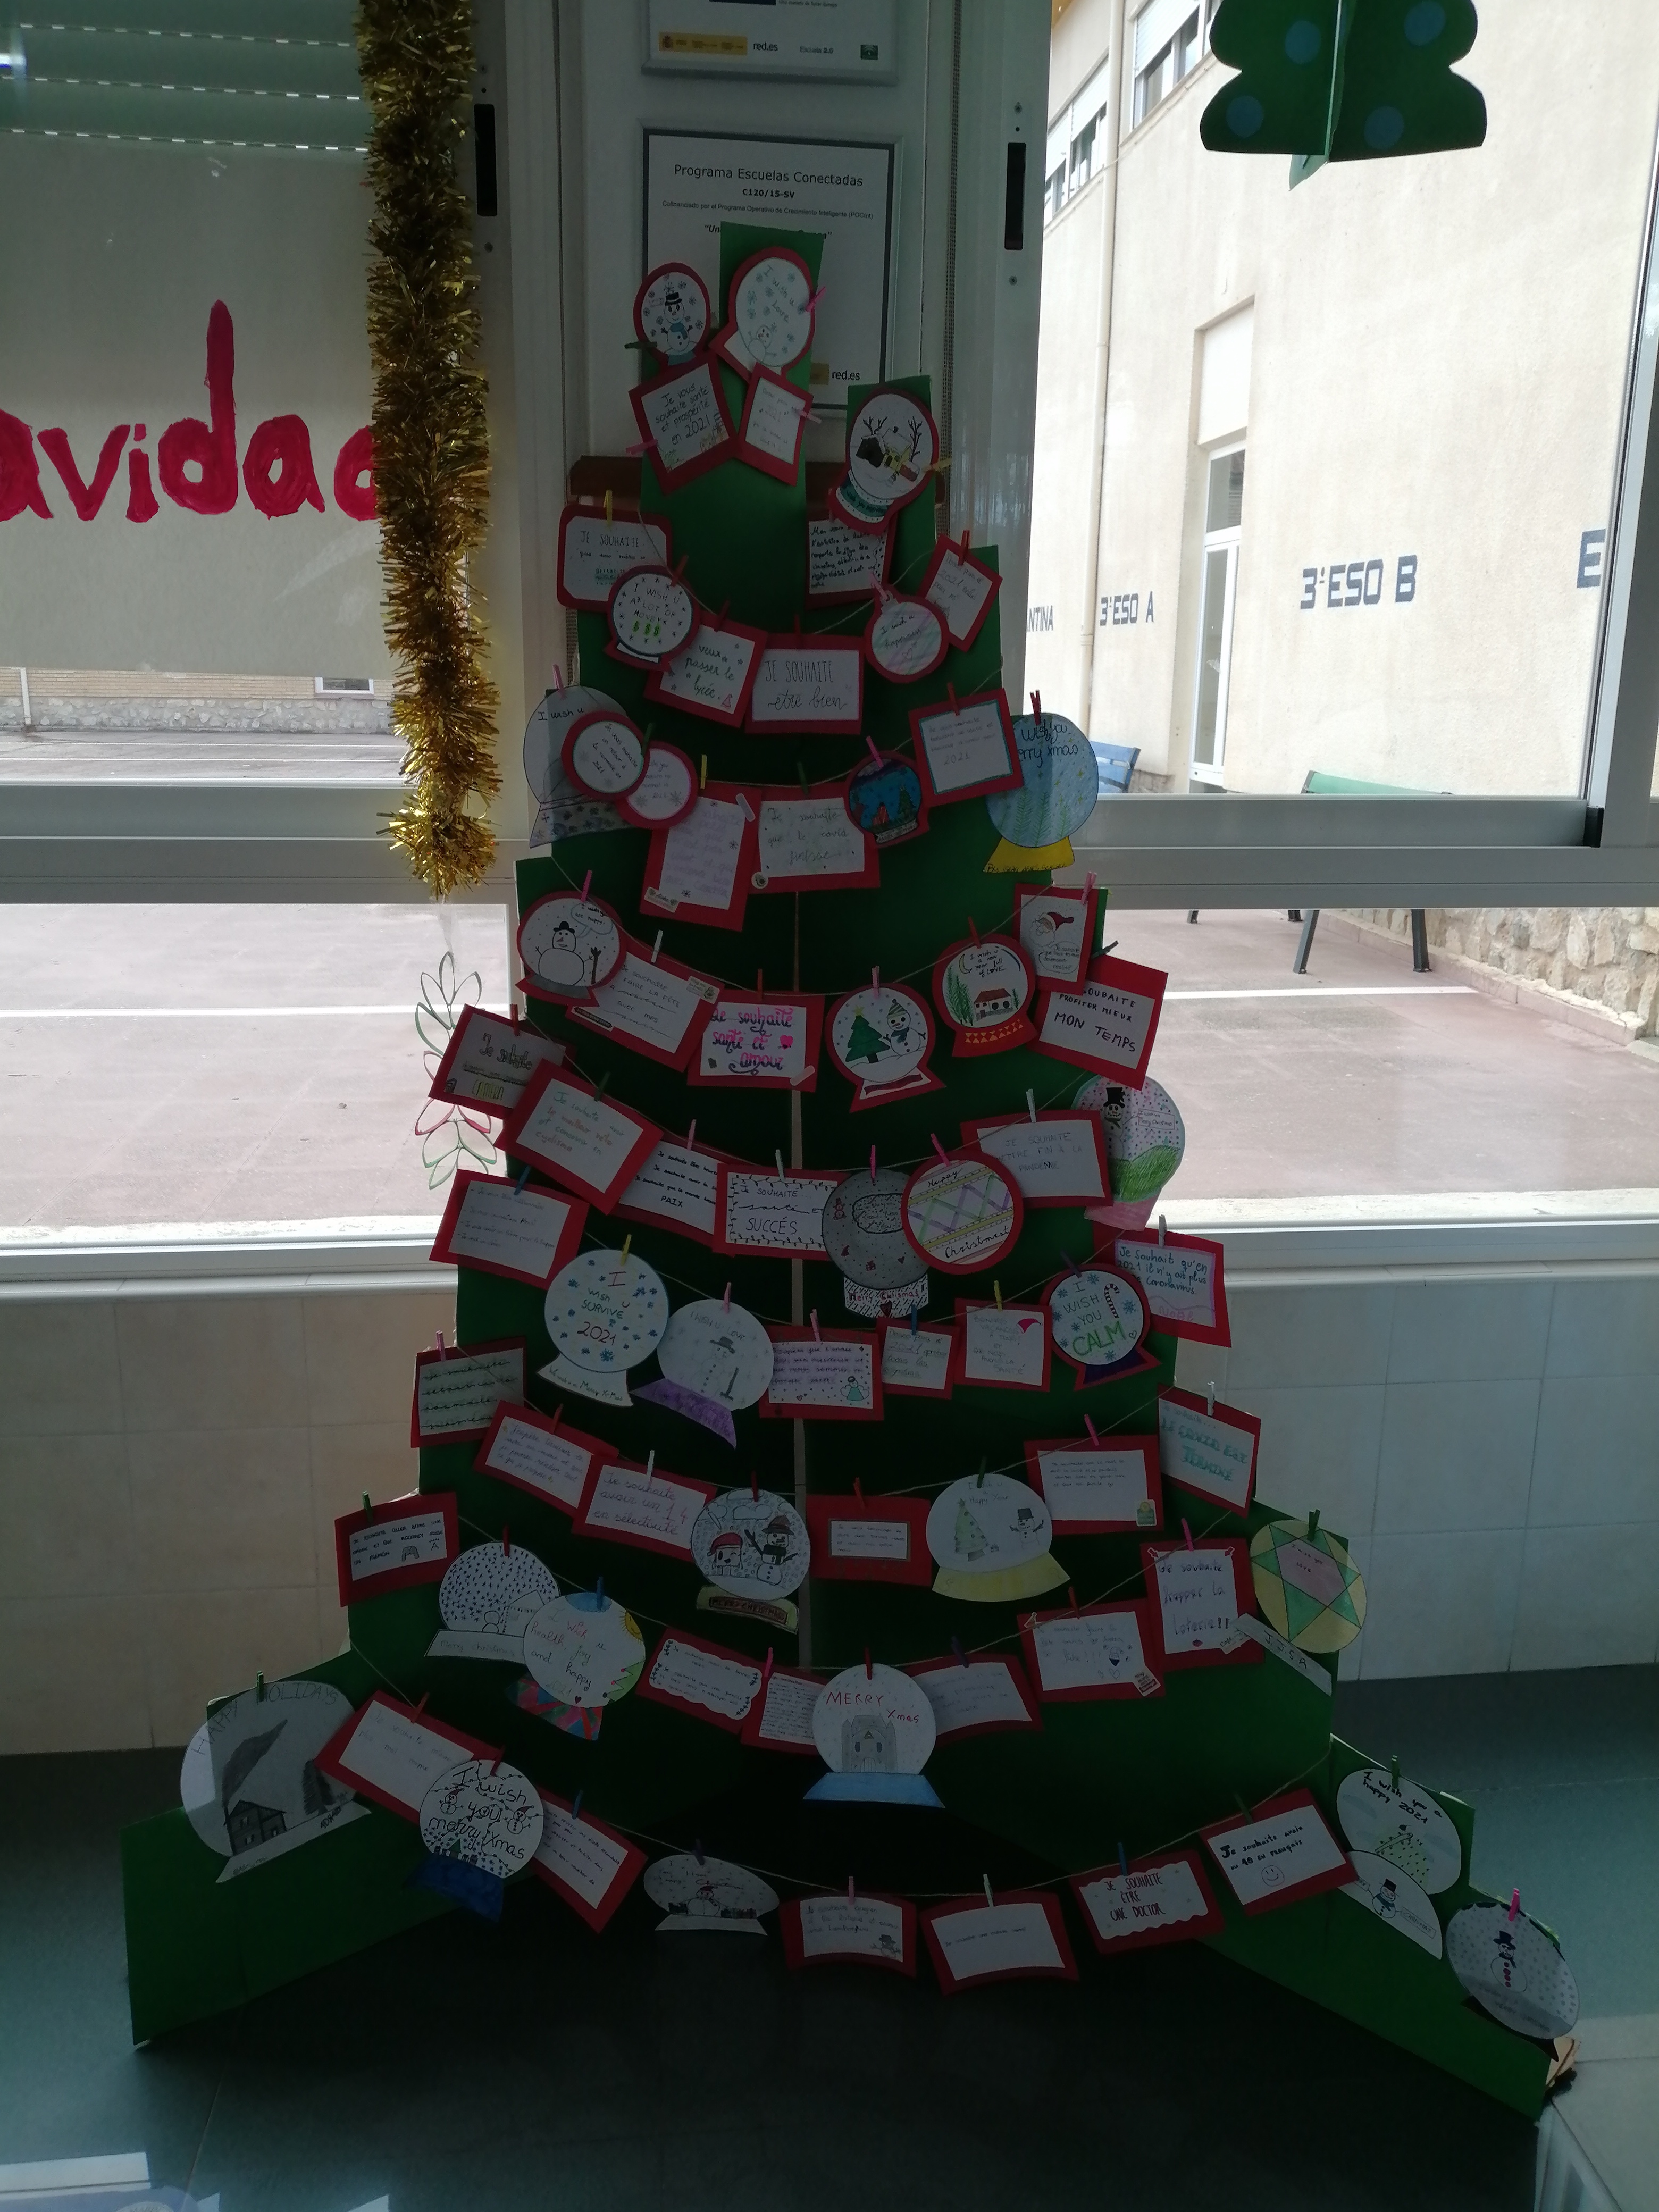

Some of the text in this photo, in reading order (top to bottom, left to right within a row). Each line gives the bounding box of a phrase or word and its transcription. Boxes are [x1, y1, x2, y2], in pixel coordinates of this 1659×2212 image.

[753, 41, 778, 52] red.es
[675, 165, 863, 186] Programa Escuelas Conectadas
[742, 189, 795, 198] C120/15-SV
[832, 370, 860, 382] red.es
[685, 415, 710, 438] 2021
[1395, 555, 1418, 603] B
[647, 588, 668, 601] WISH
[643, 601, 659, 611] LOT
[1146, 591, 1154, 623] A
[1026, 605, 1053, 632] NTINA
[765, 660, 833, 683] JE SOUHAITE
[538, 711, 547, 720] I
[551, 710, 573, 719] wish
[1018, 745, 1042, 767] erry
[623, 977, 643, 991] FAIRE
[1059, 993, 1097, 1011] PROFITER
[1054, 1012, 1136, 1052] MON TEMPS
[928, 1168, 963, 1187] Happy
[661, 1195, 683, 1208] PAIX
[1120, 1246, 1130, 1258] Je
[608, 1271, 626, 1287] I
[1073, 1282, 1085, 1292] I
[581, 1299, 624, 1319] SURVIVE
[1063, 1294, 1099, 1314] WISH
[1077, 1310, 1102, 1325] YOU
[577, 1321, 616, 1346] 2021
[1072, 1321, 1126, 1356] CALM
[566, 1662, 592, 1691] happy
[263, 1681, 338, 1705] OLIDAYS
[826, 1691, 884, 1706] MERRY
[886, 1709, 919, 1723] Xmas
[453, 1767, 526, 1805] I wish
[1364, 1772, 1373, 1781] I
[1379, 1780, 1402, 1798] wish
[1412, 1799, 1427, 1809] you
[1363, 1779, 1428, 1824] happy 2021
[468, 1802, 502, 1822] you
[429, 1817, 481, 1850] merry
[483, 1831, 524, 1859] Xmas
[1220, 1845, 1236, 1858] Je
[1242, 1834, 1277, 1852] souhaite
[1125, 1873, 1164, 1890] SOUHAITE
[1133, 1903, 1166, 1918] DOCTOR
